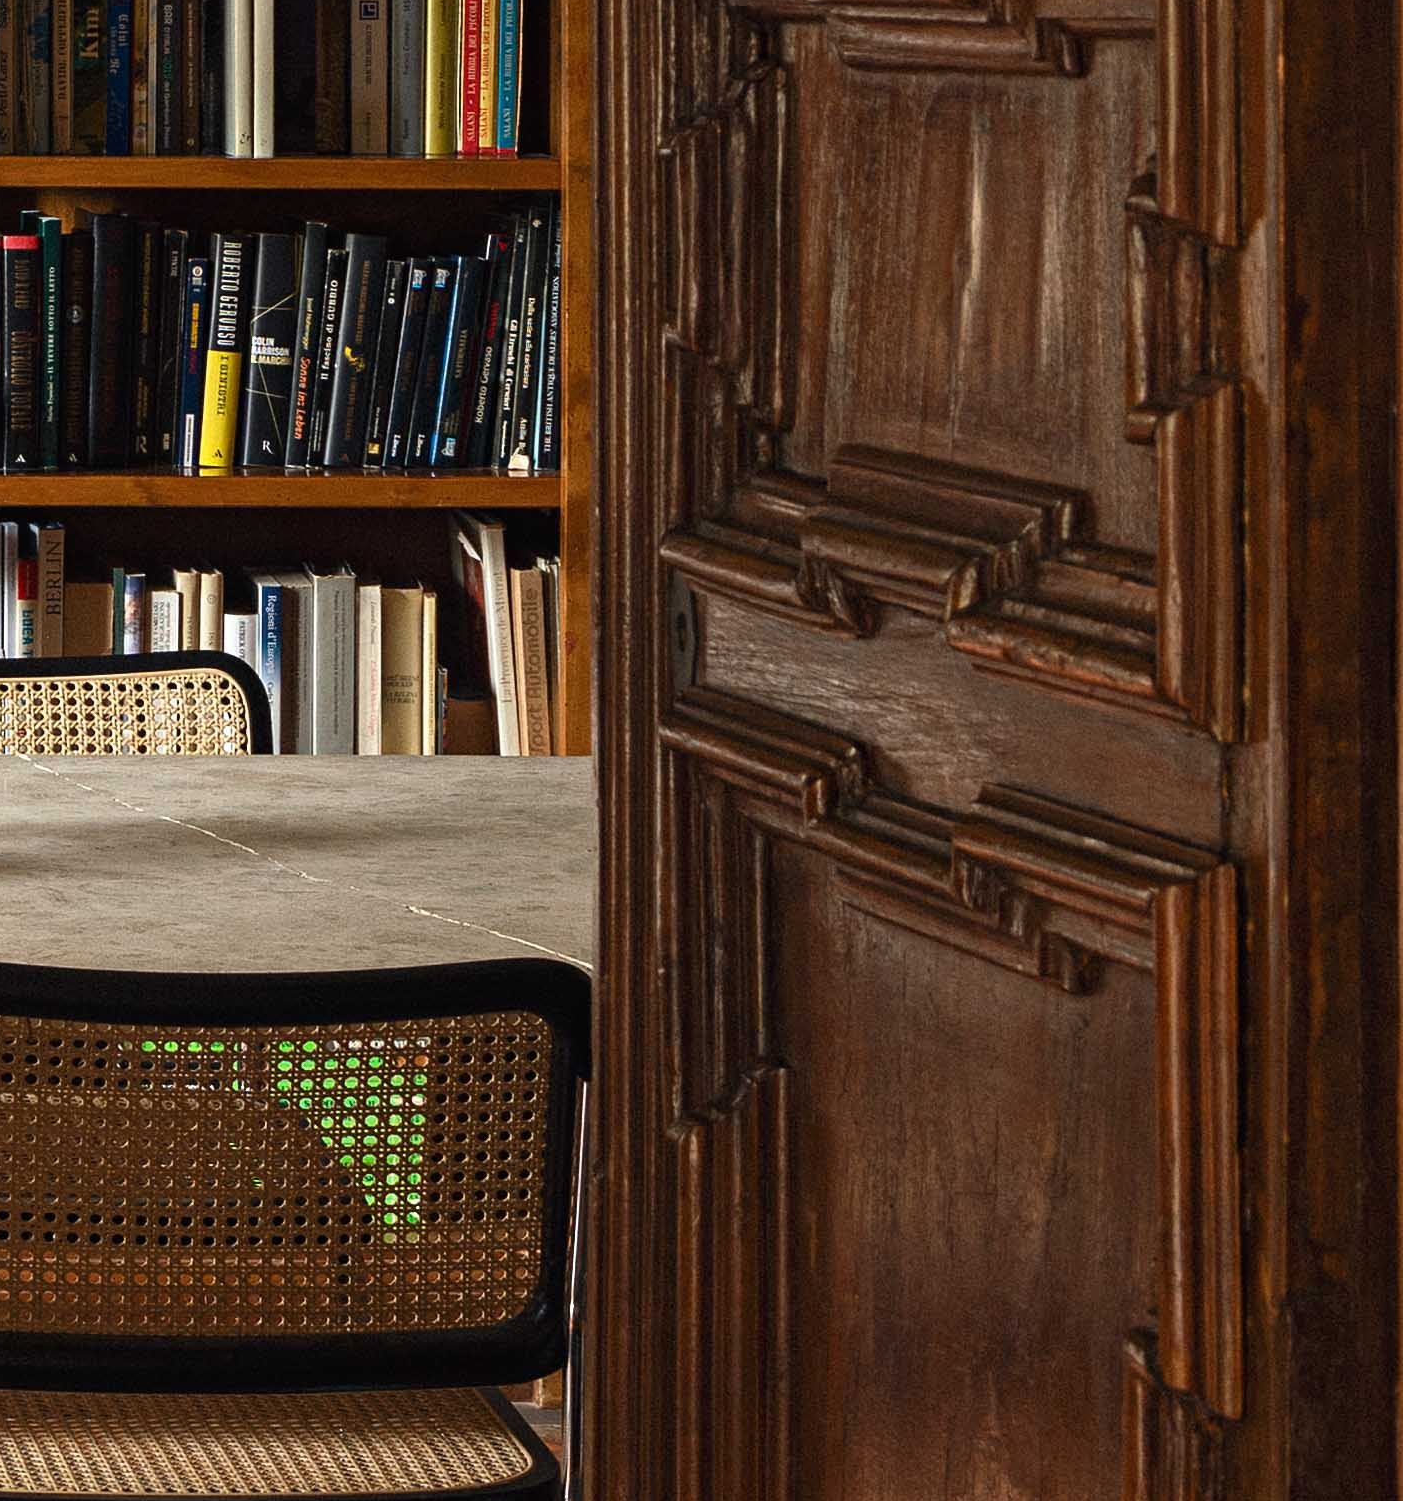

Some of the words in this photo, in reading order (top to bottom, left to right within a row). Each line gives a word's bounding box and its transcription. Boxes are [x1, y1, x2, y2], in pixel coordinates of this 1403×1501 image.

[468, 1, 478, 31] PICCOLI
[78, 6, 99, 58] Kim
[468, 34, 477, 48] DEI
[467, 52, 477, 80] BIBBIA
[467, 83, 476, 94] LA
[466, 112, 476, 142] SALANI
[48, 266, 56, 292] LETTO
[220, 242, 243, 292] ROBERTO
[327, 280, 339, 320] GUBBIO
[48, 305, 56, 331] SOTTO
[217, 294, 239, 346] GERVASO
[325, 324, 334, 333] di
[48, 334, 56, 362] TEVERE
[321, 336, 332, 369] fascino
[48, 366, 56, 374] IL
[479, 346, 494, 385] Gervaso
[475, 387, 488, 424] Roberto
[44, 541, 62, 617] BERLIN
[265, 594, 278, 627] Regioni
[520, 589, 541, 700] Automobile
